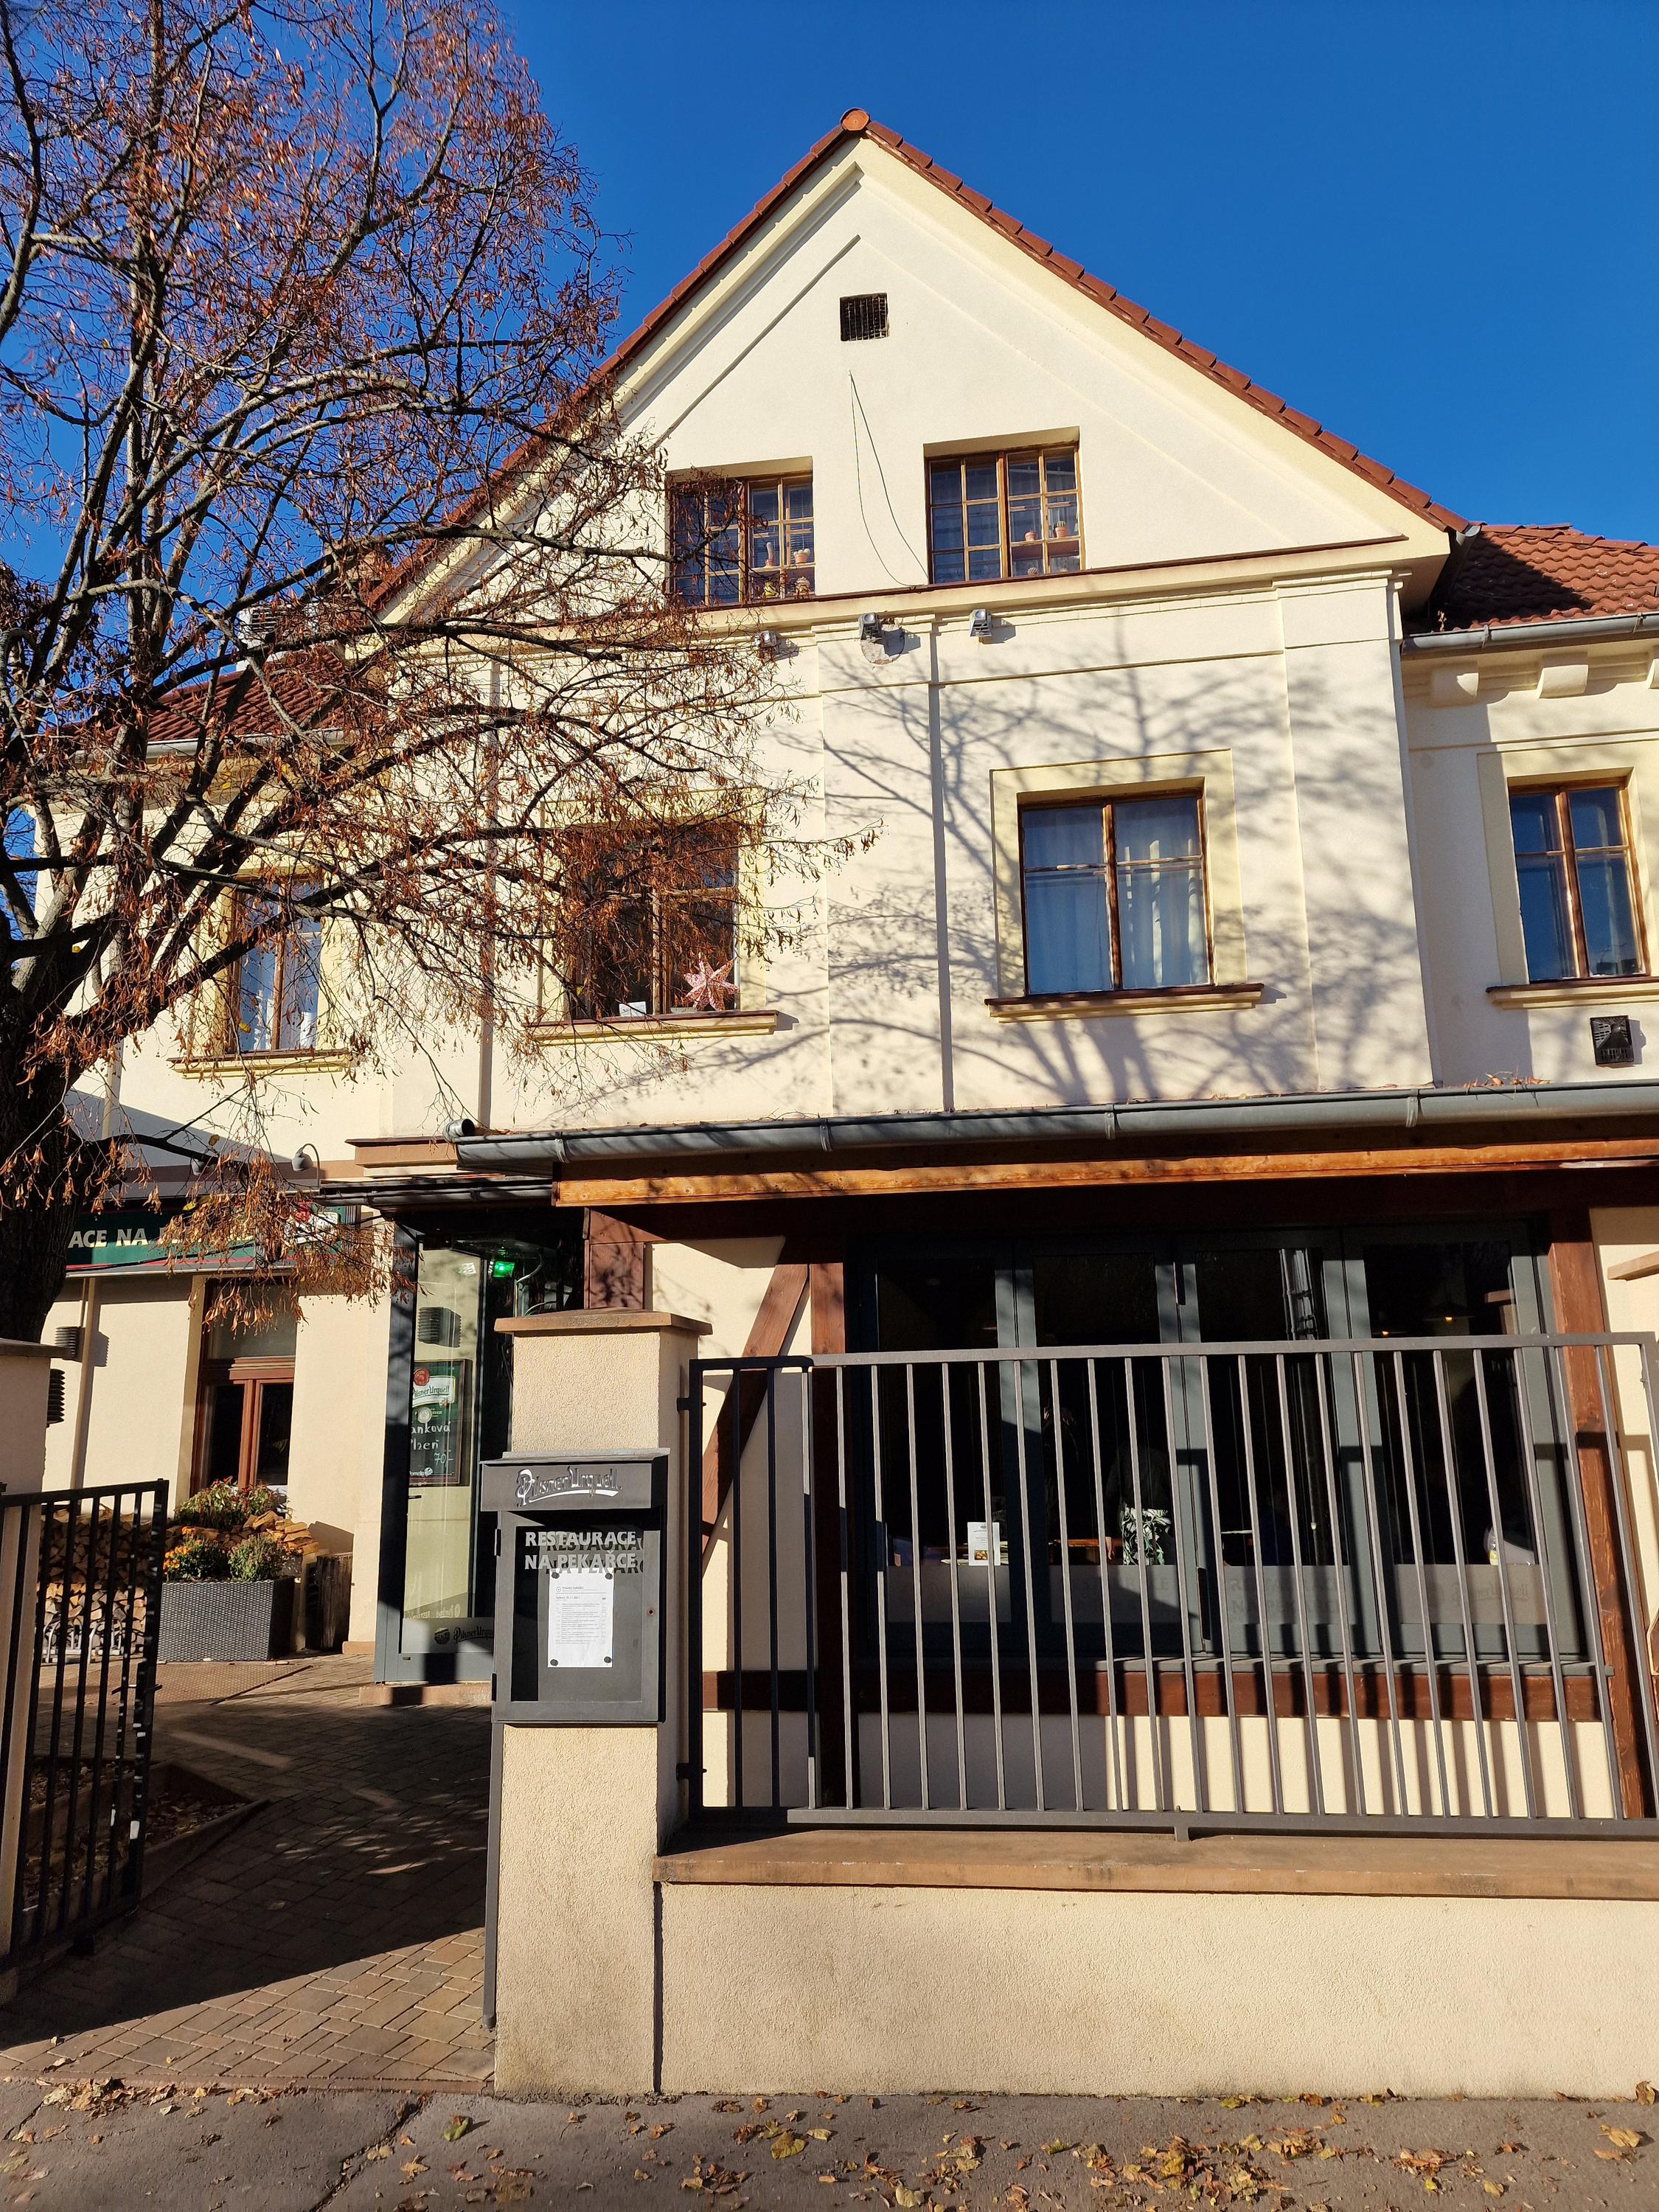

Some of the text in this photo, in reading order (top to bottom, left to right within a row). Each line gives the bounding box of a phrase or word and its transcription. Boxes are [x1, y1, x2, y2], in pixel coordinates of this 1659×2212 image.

[116, 1228, 149, 1246] NA
[429, 1385, 450, 1397] Urquell
[411, 1438, 439, 1450] lzeň
[516, 1466, 622, 1507] Pilsner Urquell
[525, 1531, 636, 1547] RESTAURACE
[524, 1550, 636, 1570] NA PEKAŘCE
